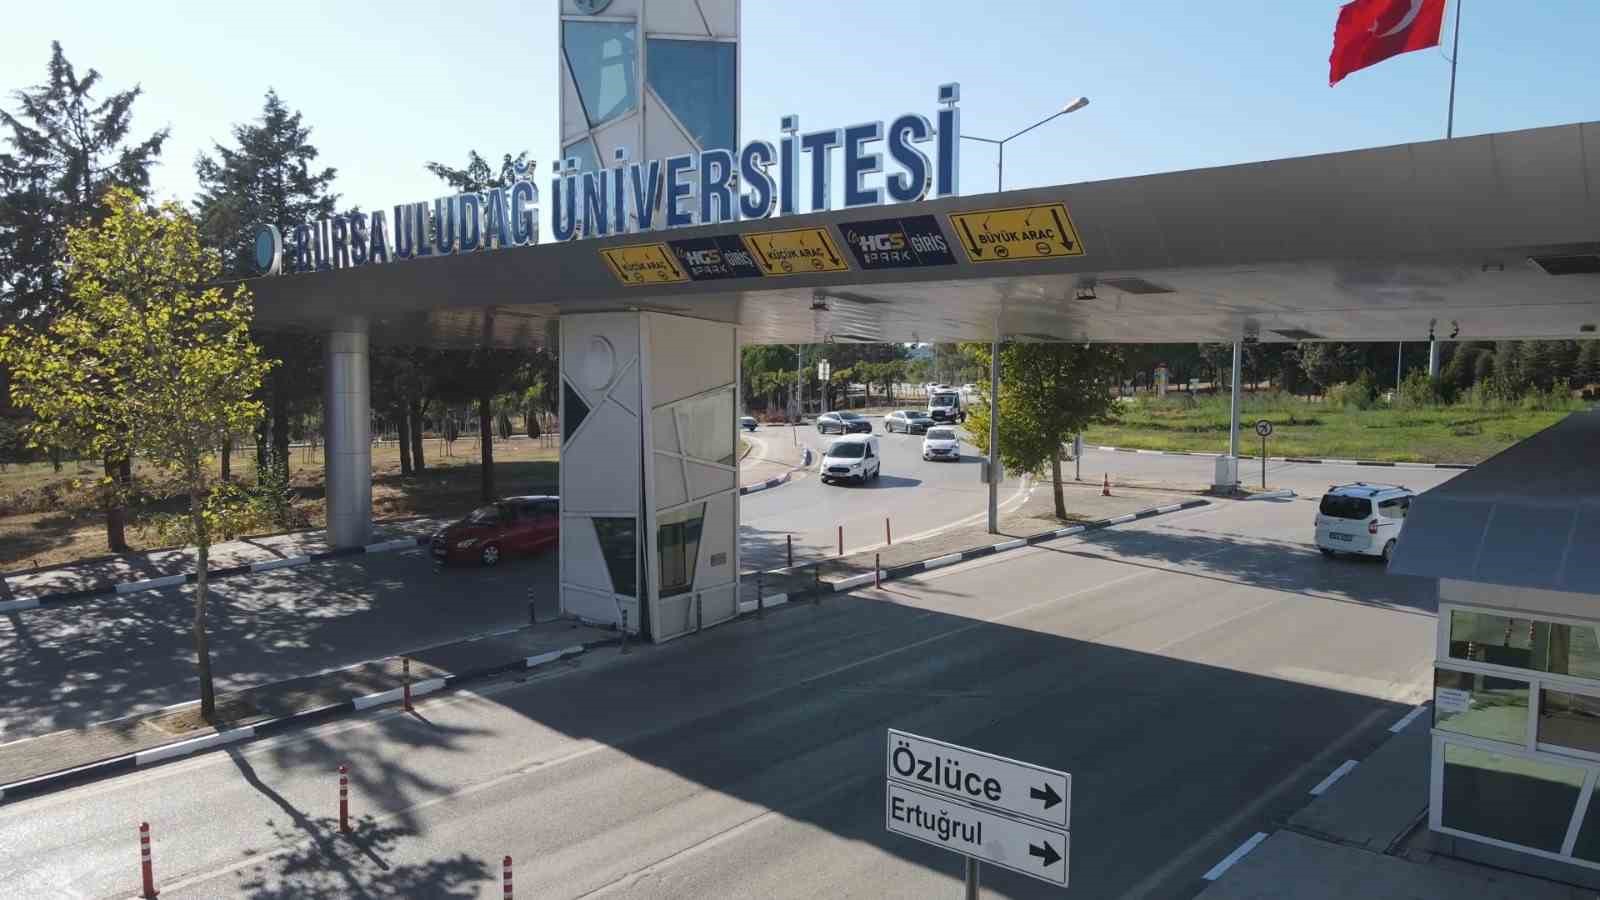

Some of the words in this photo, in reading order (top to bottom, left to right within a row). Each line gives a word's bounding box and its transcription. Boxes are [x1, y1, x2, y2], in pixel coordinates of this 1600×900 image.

[296, 210, 393, 271] BURSA
[394, 160, 540, 260] ULUDAĞ
[552, 82, 961, 242] ÜNİVERSİTESİ
[859, 232, 905, 252] HGS
[911, 232, 948, 255] GİRİŞ
[978, 231, 1018, 244] BÜYÜK
[1021, 228, 1056, 242] ARAÇ
[686, 249, 721, 265] HGS
[893, 740, 1001, 801] Özlüce
[891, 796, 982, 845] Ertuğrul
